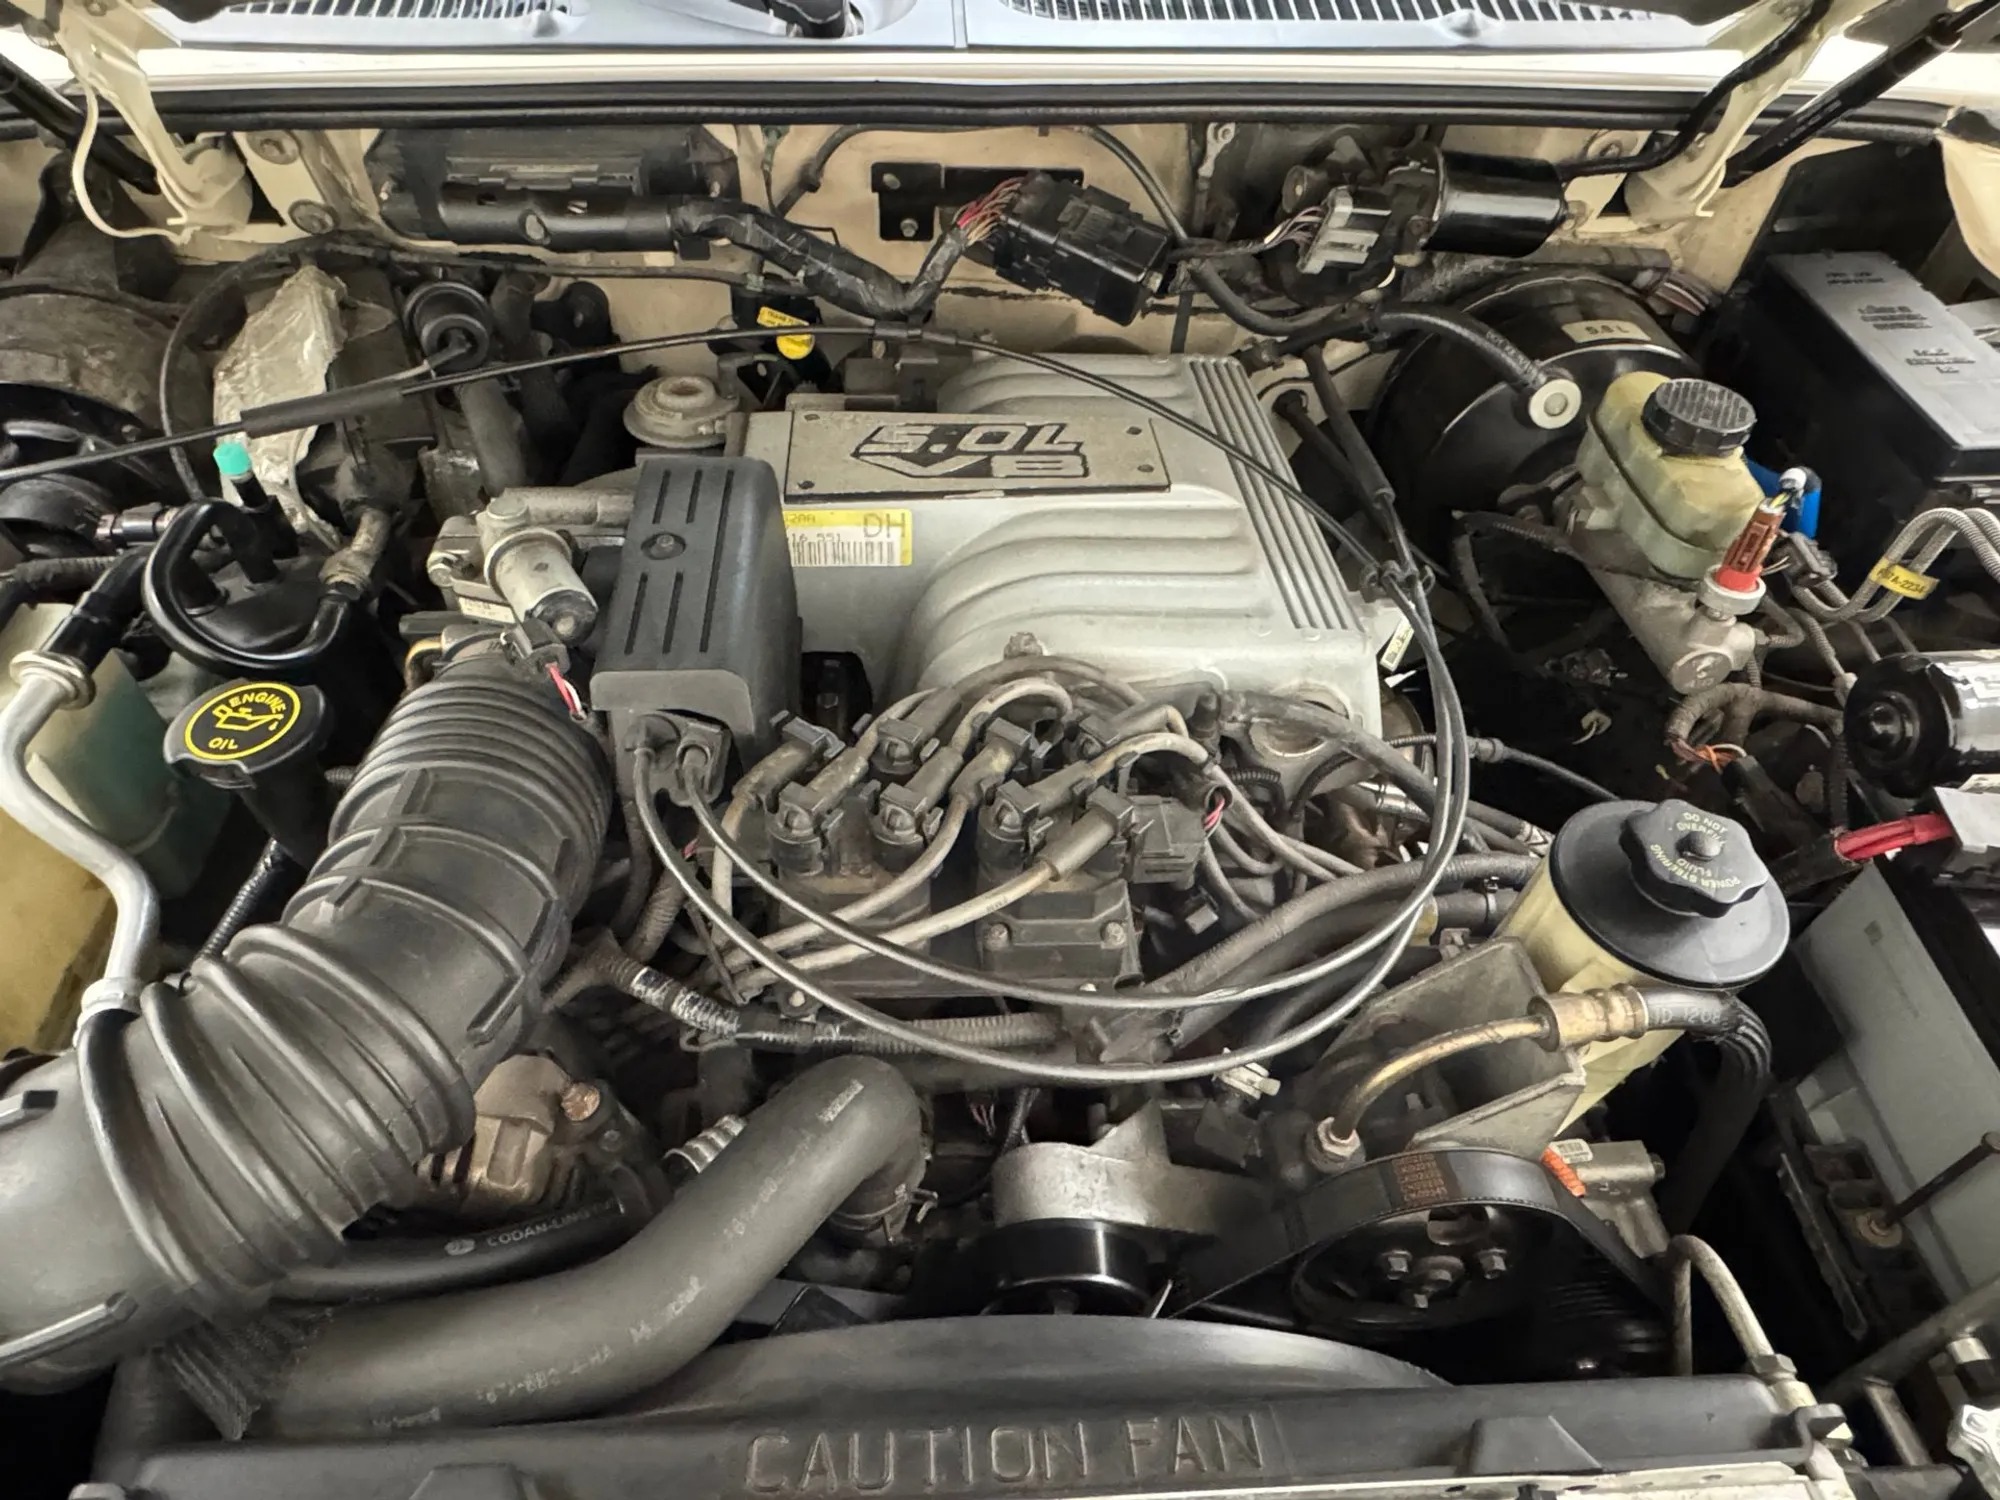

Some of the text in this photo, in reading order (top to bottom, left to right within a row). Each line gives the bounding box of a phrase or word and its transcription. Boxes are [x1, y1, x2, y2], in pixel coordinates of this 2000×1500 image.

[856, 424, 1083, 453] 5.0L
[856, 454, 1089, 478] V8
[863, 512, 906, 538] DH
[228, 692, 287, 714] ENGINE
[208, 737, 239, 750] OIL
[1682, 811, 1729, 834] DO NOT
[1650, 844, 1699, 883] STEERING
[1676, 858, 1713, 878] FLUID
[745, 1413, 1265, 1494] CAUTION FAN
